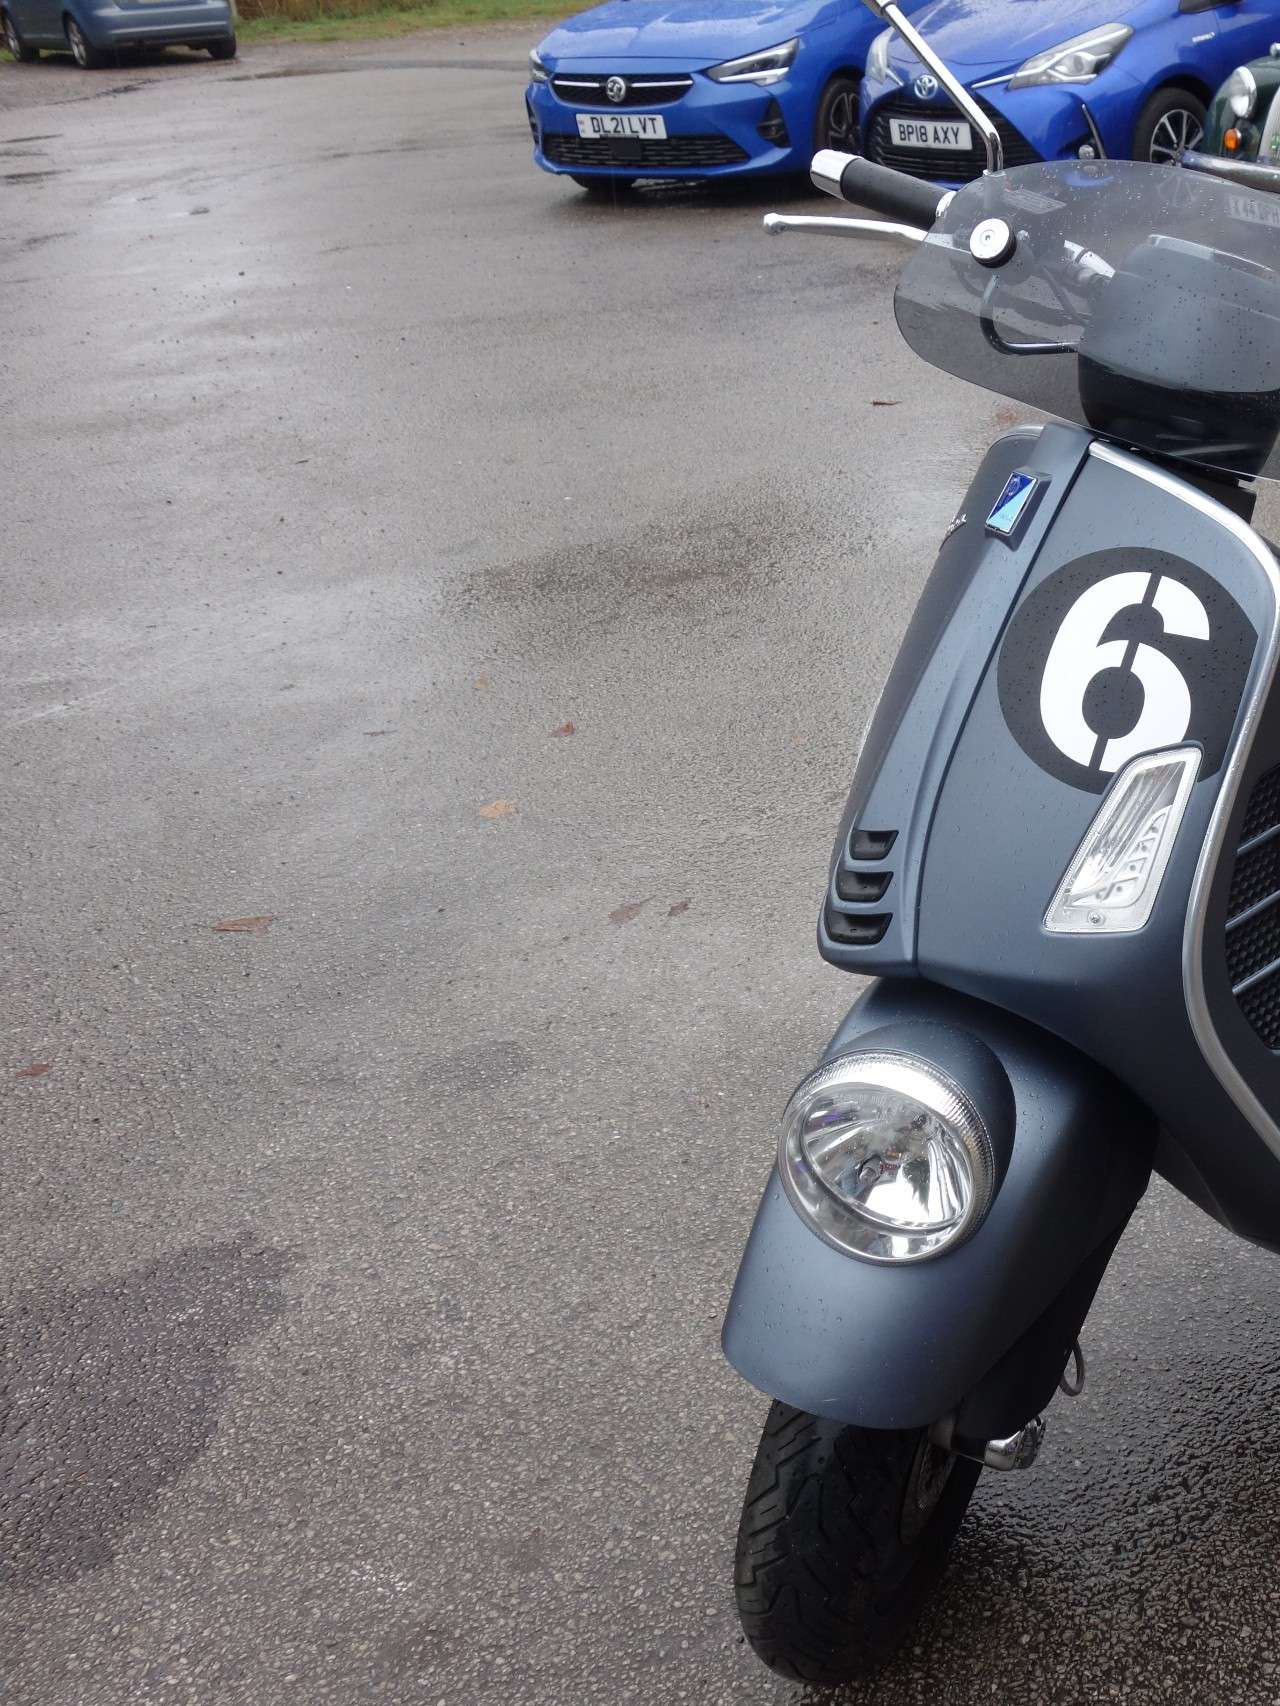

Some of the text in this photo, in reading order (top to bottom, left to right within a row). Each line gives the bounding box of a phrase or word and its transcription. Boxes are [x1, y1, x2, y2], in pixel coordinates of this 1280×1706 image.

[590, 117, 657, 135] DL21 LVT
[898, 124, 959, 145] BP18 AXY
[1040, 571, 1210, 773] 6
